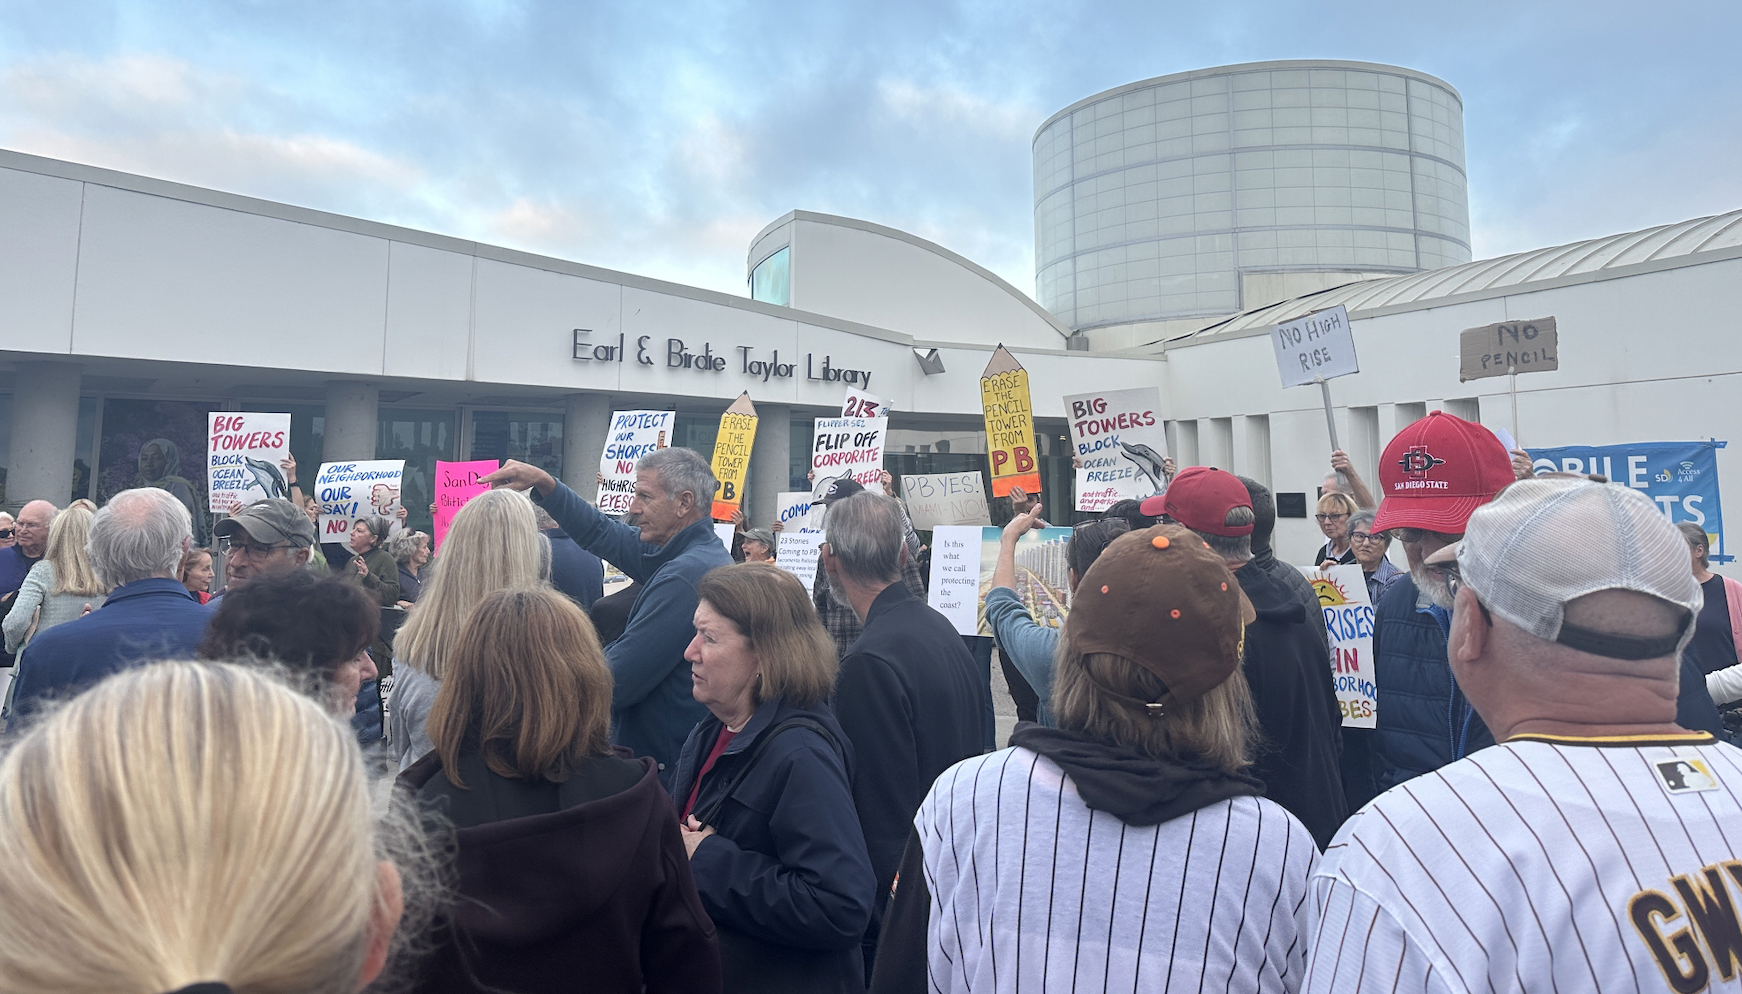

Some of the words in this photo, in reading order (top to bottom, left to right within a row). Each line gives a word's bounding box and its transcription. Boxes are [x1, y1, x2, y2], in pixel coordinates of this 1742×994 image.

[1279, 327, 1302, 350] NO
[1305, 313, 1341, 342] HIGH
[1497, 324, 1539, 346] NO
[572, 328, 625, 363] Earl
[637, 335, 654, 366] &
[666, 337, 726, 372] Birdie
[736, 345, 797, 382] Taylor
[807, 353, 871, 390] Library
[1299, 347, 1332, 373] RISE
[1481, 348, 1555, 370] PENCIL
[983, 375, 1020, 393] ERASE
[995, 390, 1014, 401] THE
[985, 399, 1029, 419] PENCIL
[1072, 398, 1107, 420] BIG
[213, 416, 245, 434] BIG
[614, 413, 669, 430] PROTECT
[722, 416, 753, 431] ERASE
[817, 420, 849, 429] FLIPPER
[988, 414, 1027, 433] TOWER
[1074, 411, 1155, 438] TOWERS
[211, 431, 285, 451] TOWERS
[615, 432, 634, 442] OUR
[728, 432, 744, 444] THE
[815, 433, 850, 452] FLIP
[854, 431, 879, 448] OFF
[993, 430, 1025, 448] FROM
[1078, 434, 1121, 455] BLOCK
[715, 442, 749, 457] PENCIL
[211, 454, 244, 466] BLOCK
[718, 456, 744, 470] TOWER
[813, 447, 880, 468] CORPORATE
[992, 446, 1034, 475] PB
[1083, 456, 1117, 469] OCEAN
[212, 469, 245, 479] OCEAN
[327, 464, 357, 474] OUR
[615, 460, 634, 474] NO
[718, 468, 738, 480] FROM
[1086, 467, 1133, 482] BREEZE
[213, 479, 250, 490] BREEZE
[318, 470, 402, 485] NEIGHBORHOOD
[443, 470, 467, 488] San
[1655, 474, 1669, 482] SD
[601, 478, 637, 493] HIGHRIS
[904, 476, 935, 498] PB
[937, 473, 979, 497] YES!
[1394, 482, 1404, 490] SAN
[1405, 481, 1425, 489] DIEGO
[1426, 481, 1449, 489] STATE
[321, 486, 352, 502] OUR
[326, 520, 348, 534] NO
[788, 537, 810, 545] Stories
[944, 540, 950, 548] Is
[951, 540, 964, 548] this
[778, 548, 801, 556] Coming
[943, 552, 960, 560] what
[941, 577, 976, 587] protecting
[940, 601, 961, 609] coast?
[1335, 647, 1360, 674] IN
